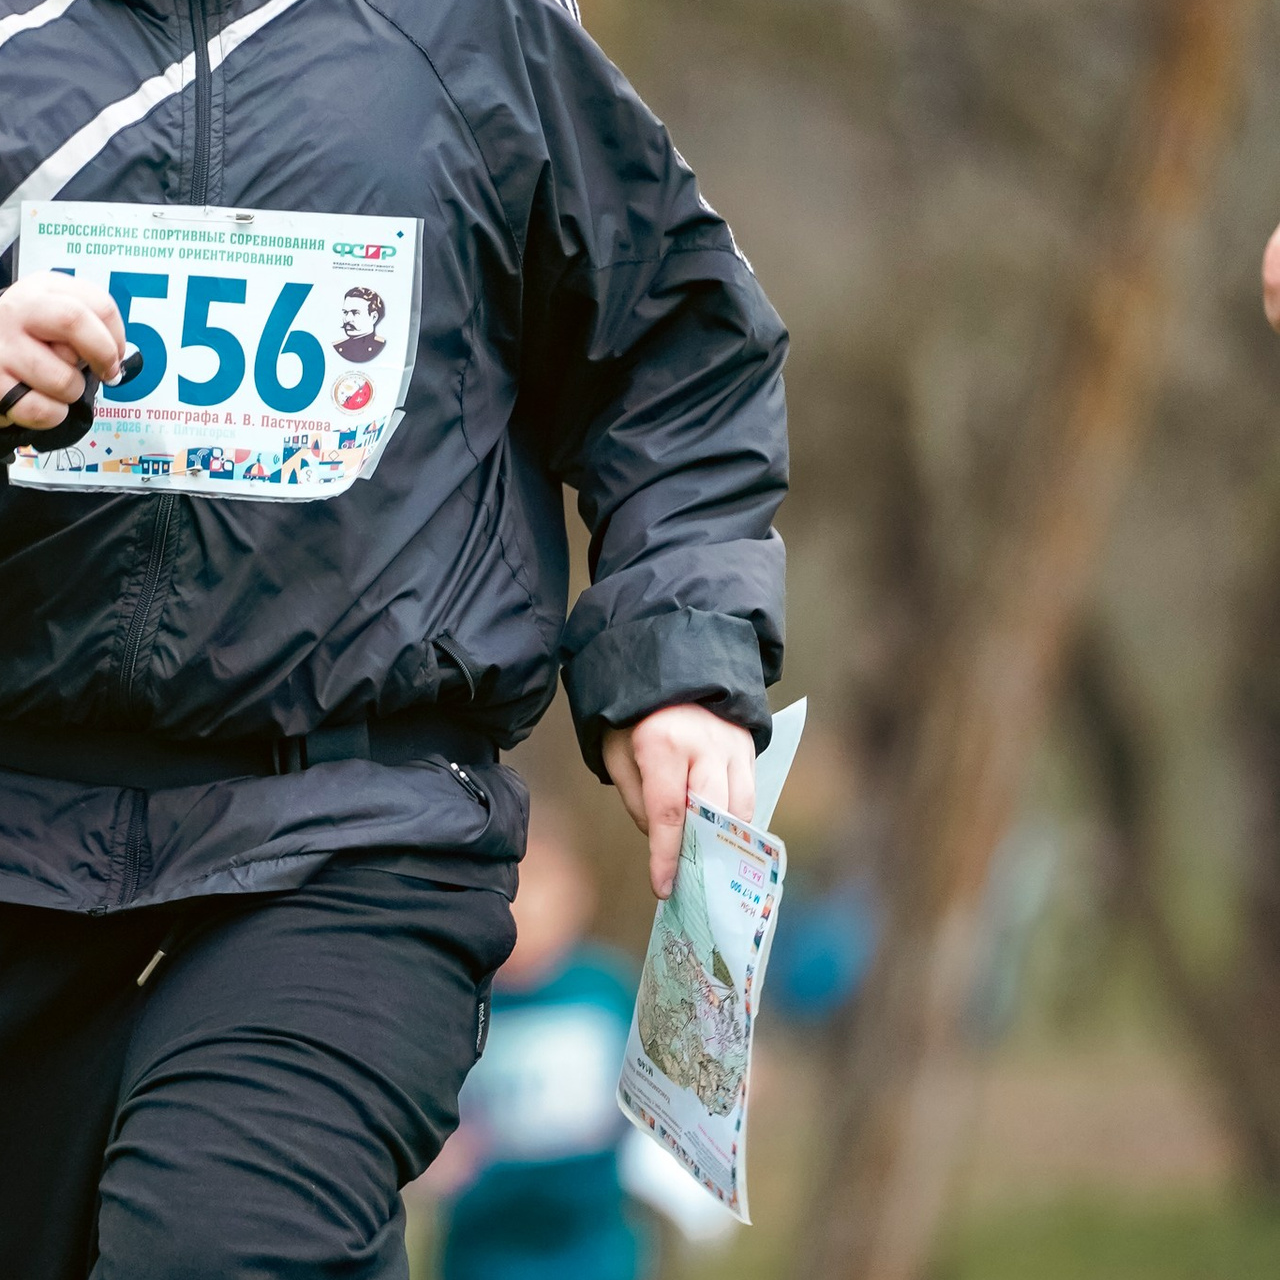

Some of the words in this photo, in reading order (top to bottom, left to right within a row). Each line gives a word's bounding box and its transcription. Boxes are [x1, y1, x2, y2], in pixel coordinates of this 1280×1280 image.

[38, 223, 139, 239] ВСЕРОССИЙСКИЕ
[143, 228, 226, 244] СПОРТИВНЫЕ
[230, 233, 325, 251] СОРЕВНОВАНИЯ
[66, 242, 82, 255] ПО
[86, 243, 174, 259] СПОРТИВНОМУ
[178, 248, 294, 267] ОРИЕНТИРОВАНИЮ
[50, 268, 326, 413] 556
[116, 421, 141, 433] 2026
[146, 409, 219, 426] топографа
[224, 412, 237, 425] А.
[242, 414, 255, 427] В.
[261, 415, 331, 433] Пастухова
